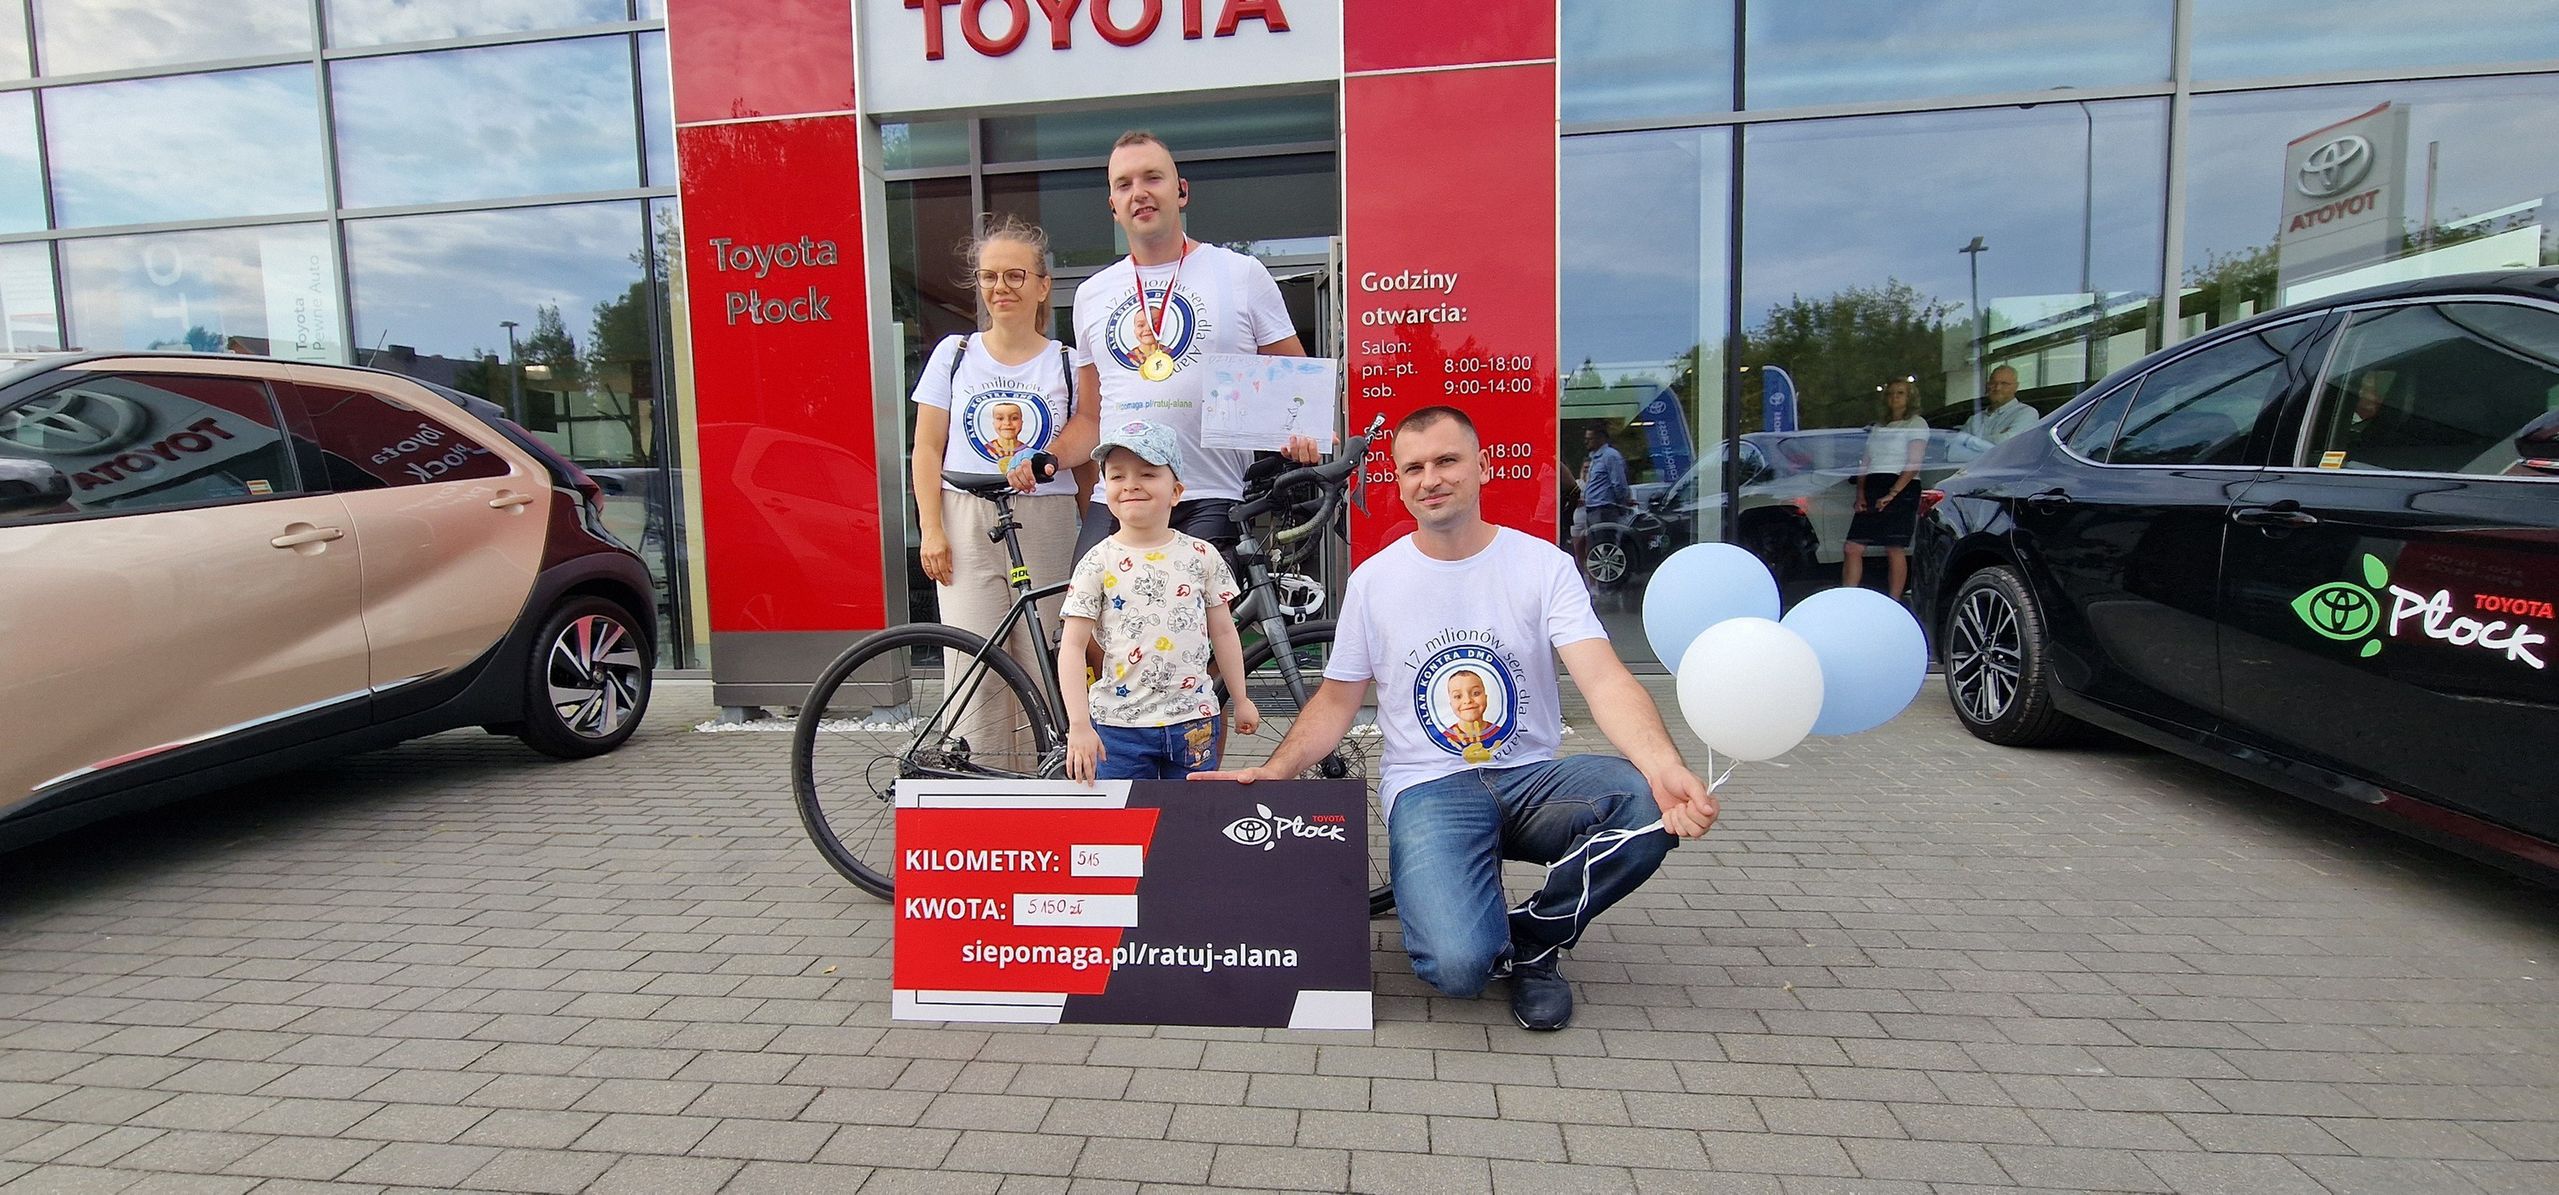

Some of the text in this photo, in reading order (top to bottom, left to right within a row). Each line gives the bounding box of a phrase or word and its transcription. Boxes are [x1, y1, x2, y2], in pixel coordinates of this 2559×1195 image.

[904, 0, 1291, 61] TOYOTA
[709, 235, 838, 279] Toyota
[1360, 269, 1458, 295] Godziny
[726, 286, 832, 326] Płock
[1361, 302, 1468, 326] otwarcia:
[1196, 319, 1212, 340] dla
[1172, 344, 1202, 374] Alan
[1361, 340, 1412, 355] Salon:
[1362, 356, 1532, 380] pn.-pt. 8:00-18:00
[1362, 378, 1532, 397] sob. 9:00-14:00
[2389, 584, 2556, 670] Płock TOYOTA
[1404, 649, 1422, 670] 17
[1425, 627, 1505, 652] milionów
[1504, 652, 1527, 683] serc
[1518, 688, 1531, 715] dla
[1418, 650, 1494, 726] ALAN KONTRA DMD
[1273, 815, 1346, 842] Płock TOYOTA
[905, 849, 1060, 872] KILOMETRY:
[1077, 850, 1100, 867] 515
[904, 897, 1007, 920] KWOTA:
[962, 940, 1298, 973] siepomaga.pl/ratuj-alana
